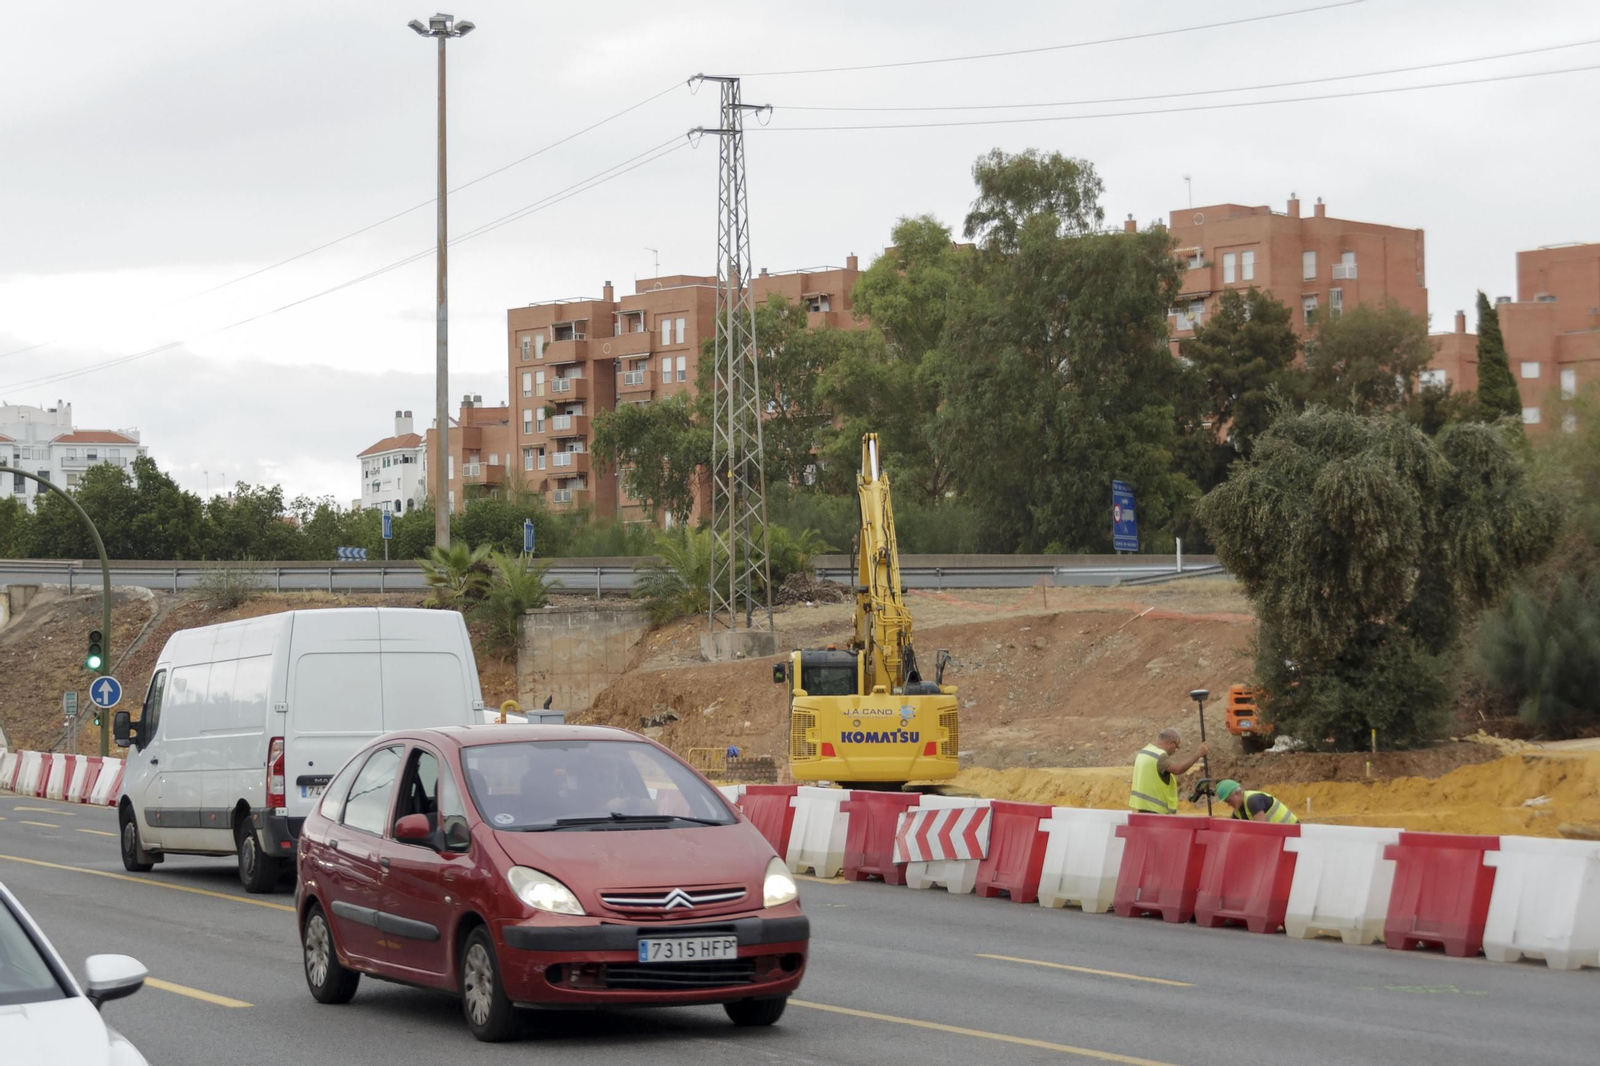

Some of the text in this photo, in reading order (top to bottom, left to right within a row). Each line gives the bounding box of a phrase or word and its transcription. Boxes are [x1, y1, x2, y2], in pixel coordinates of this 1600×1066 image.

[841, 728, 920, 744] KOMATSU
[652, 939, 733, 959] 7315 HFP
